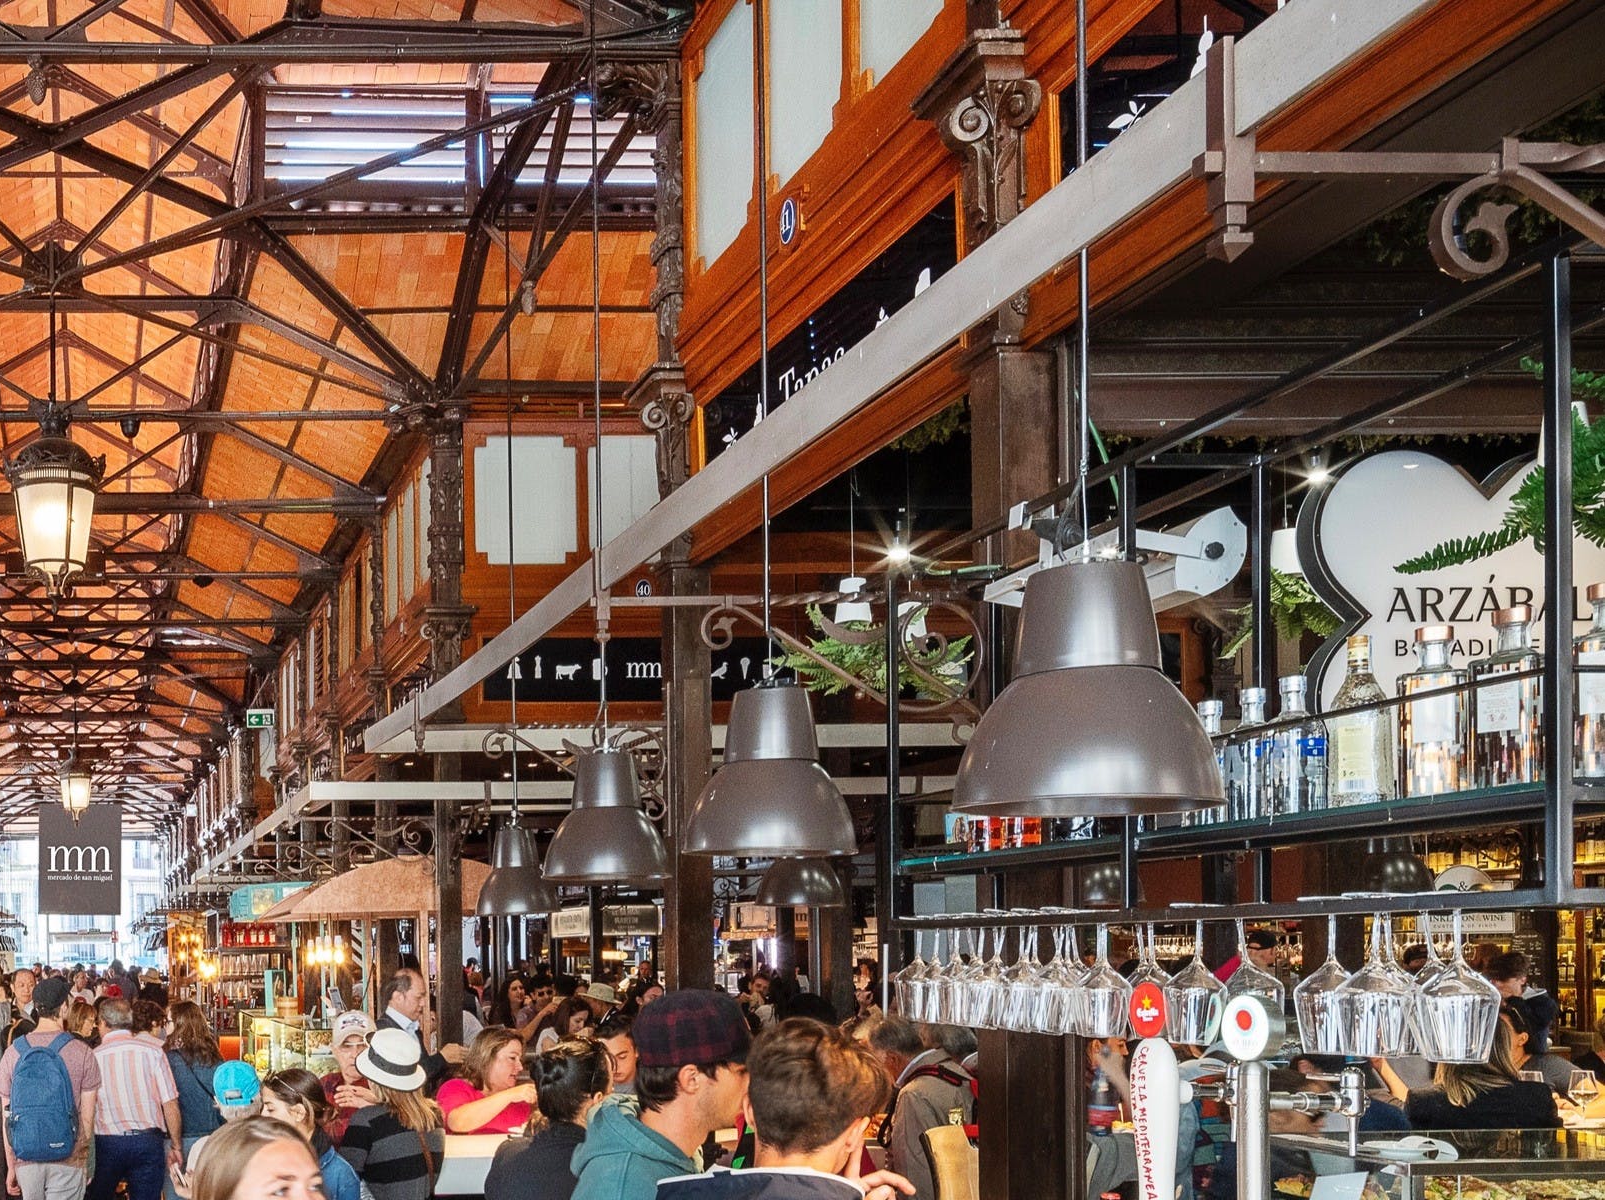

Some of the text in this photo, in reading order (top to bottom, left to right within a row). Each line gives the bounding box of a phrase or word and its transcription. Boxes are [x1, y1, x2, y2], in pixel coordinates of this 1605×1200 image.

[638, 585, 650, 596] 40
[1386, 574, 1593, 623] ARZÁBL
[47, 873, 72, 881] mercado
[74, 873, 81, 881] de
[93, 873, 113, 883] miguel
